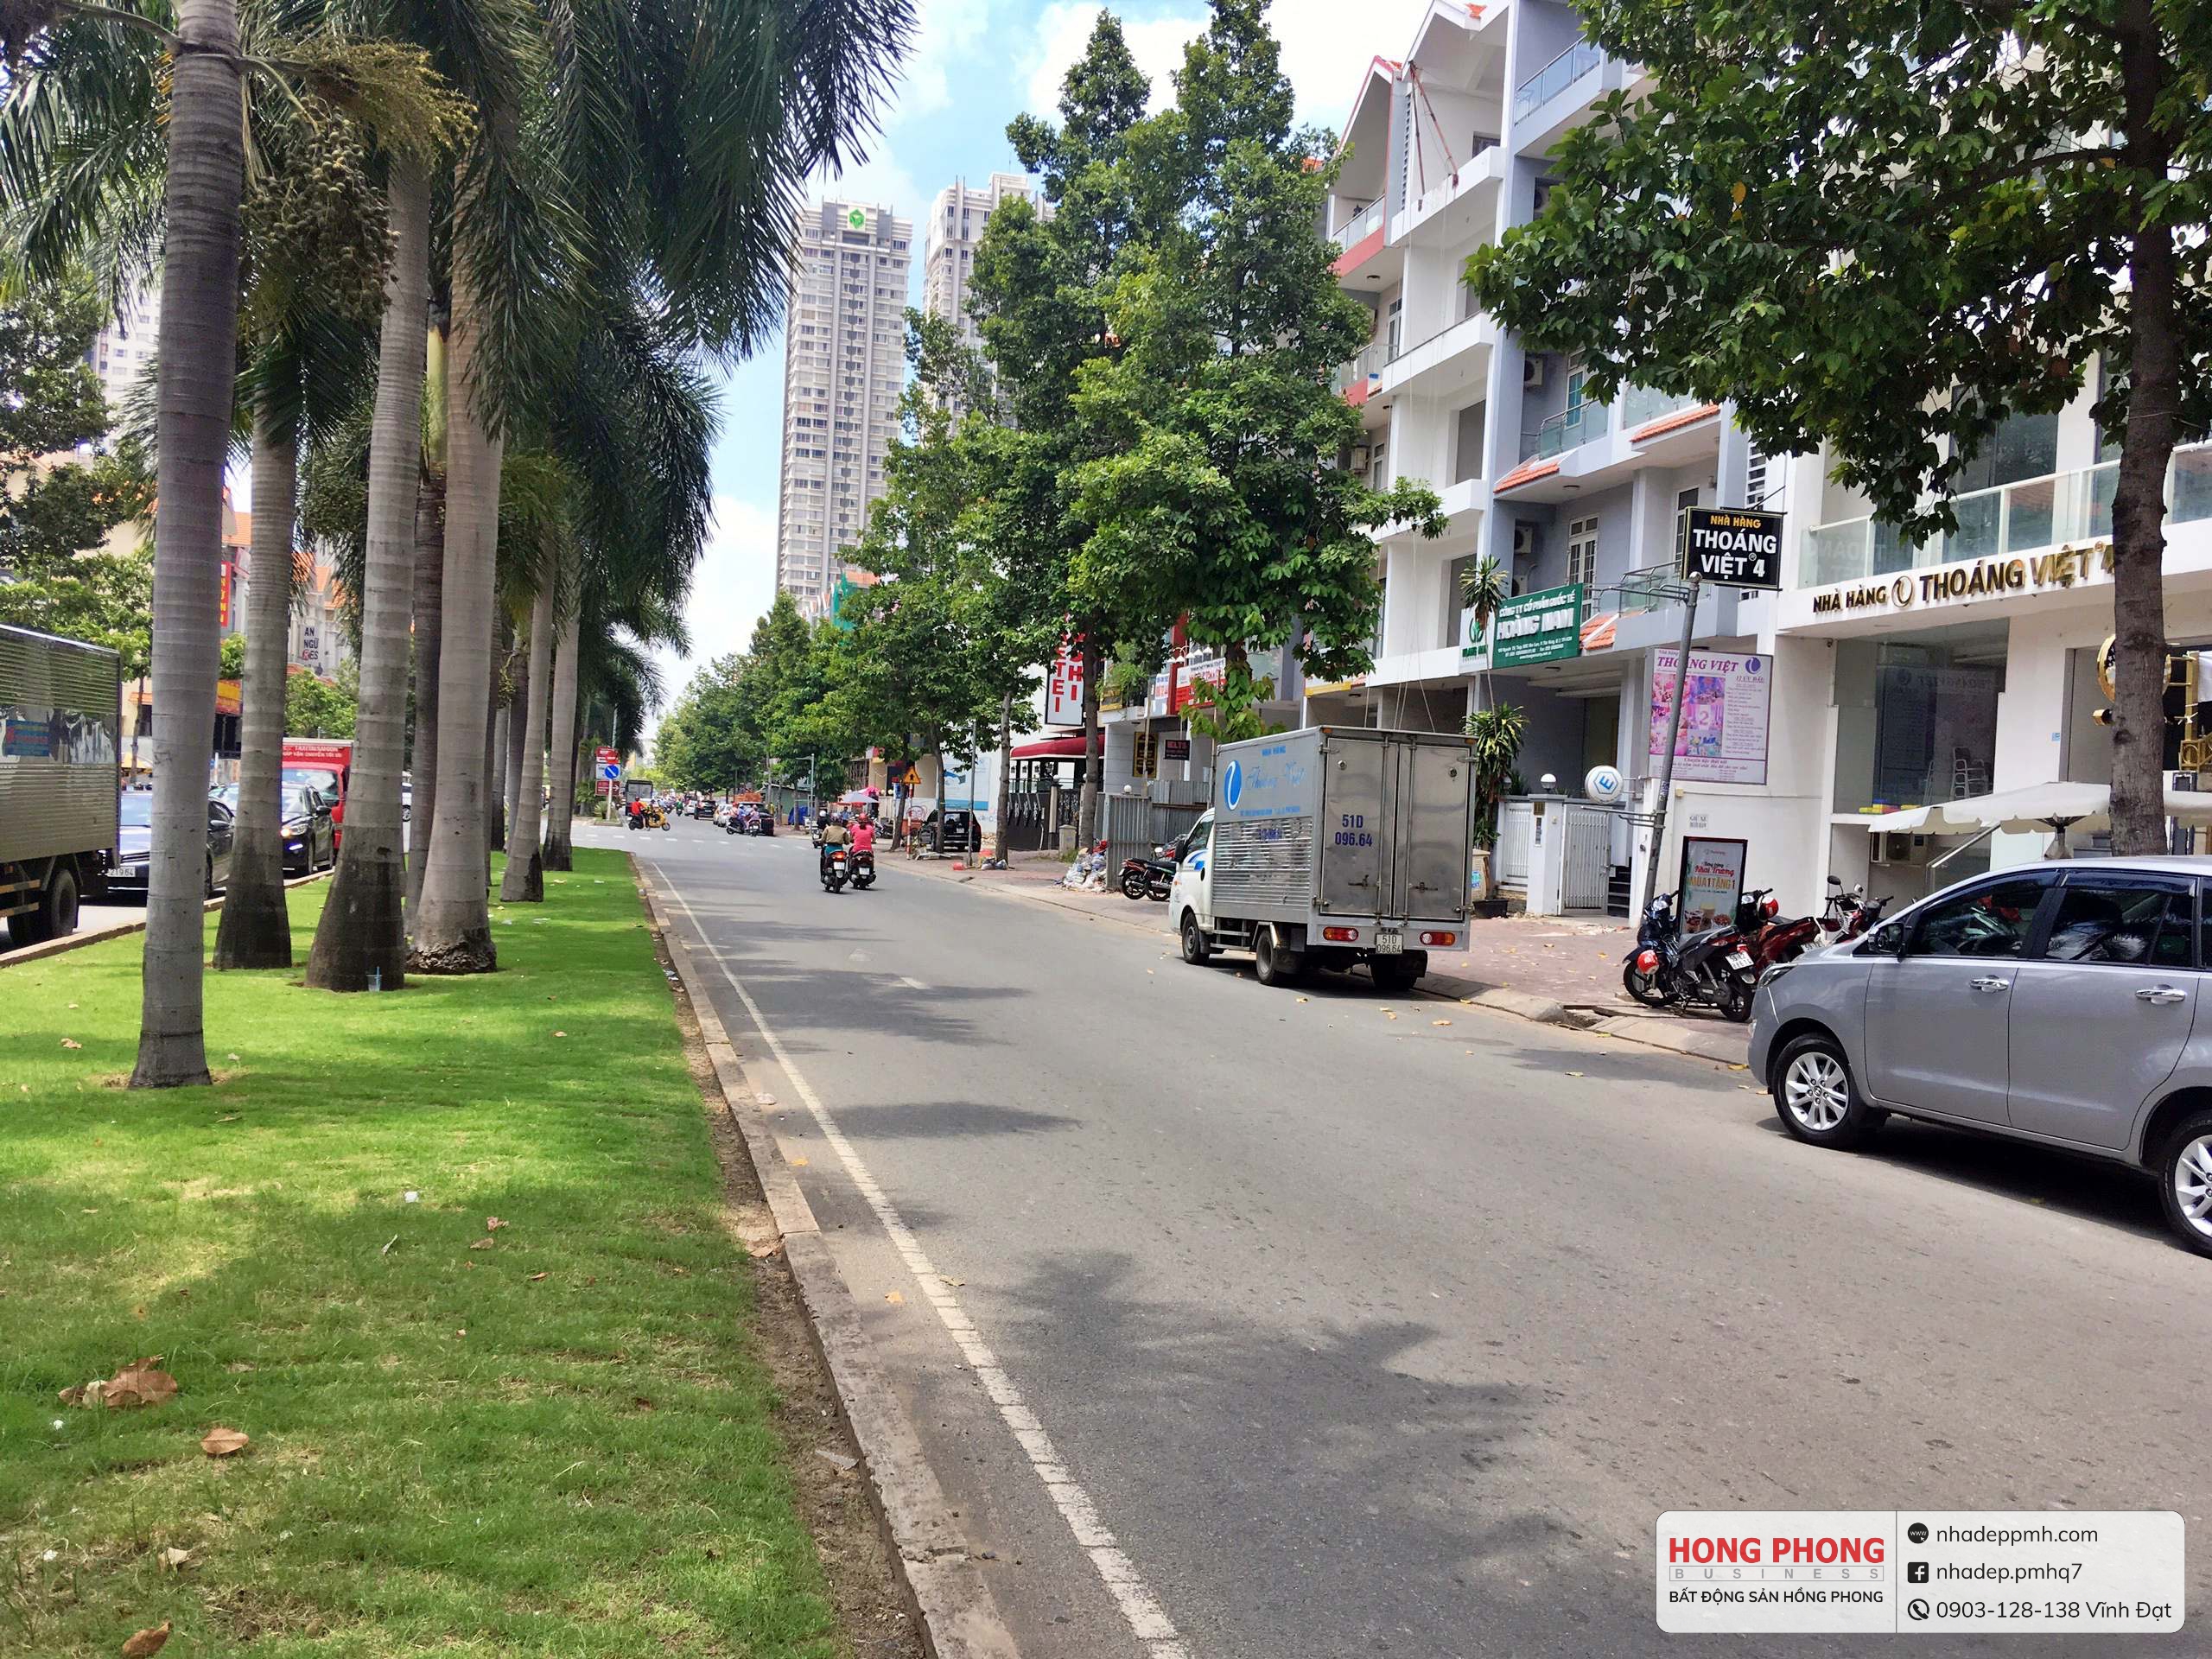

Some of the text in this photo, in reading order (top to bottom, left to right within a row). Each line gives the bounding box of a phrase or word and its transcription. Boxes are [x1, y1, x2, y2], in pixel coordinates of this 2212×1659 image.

[1711, 515, 1762, 529] NHÀ HÀNG
[1694, 529, 1777, 554] THOÁNG
[1700, 552, 1765, 580] VIỆT 4
[1813, 588, 1840, 613] NHÀ
[1846, 584, 1887, 609] HÀNG
[1919, 559, 2024, 602] THOÁNG
[2030, 544, 2094, 588] VIỆT
[1497, 607, 1574, 640] HOÀNG NAM
[1711, 660, 1738, 674] VIỆT
[1342, 814, 1363, 829] 51D
[1335, 831, 1373, 847] 096.64
[1382, 935, 1397, 944] 51D
